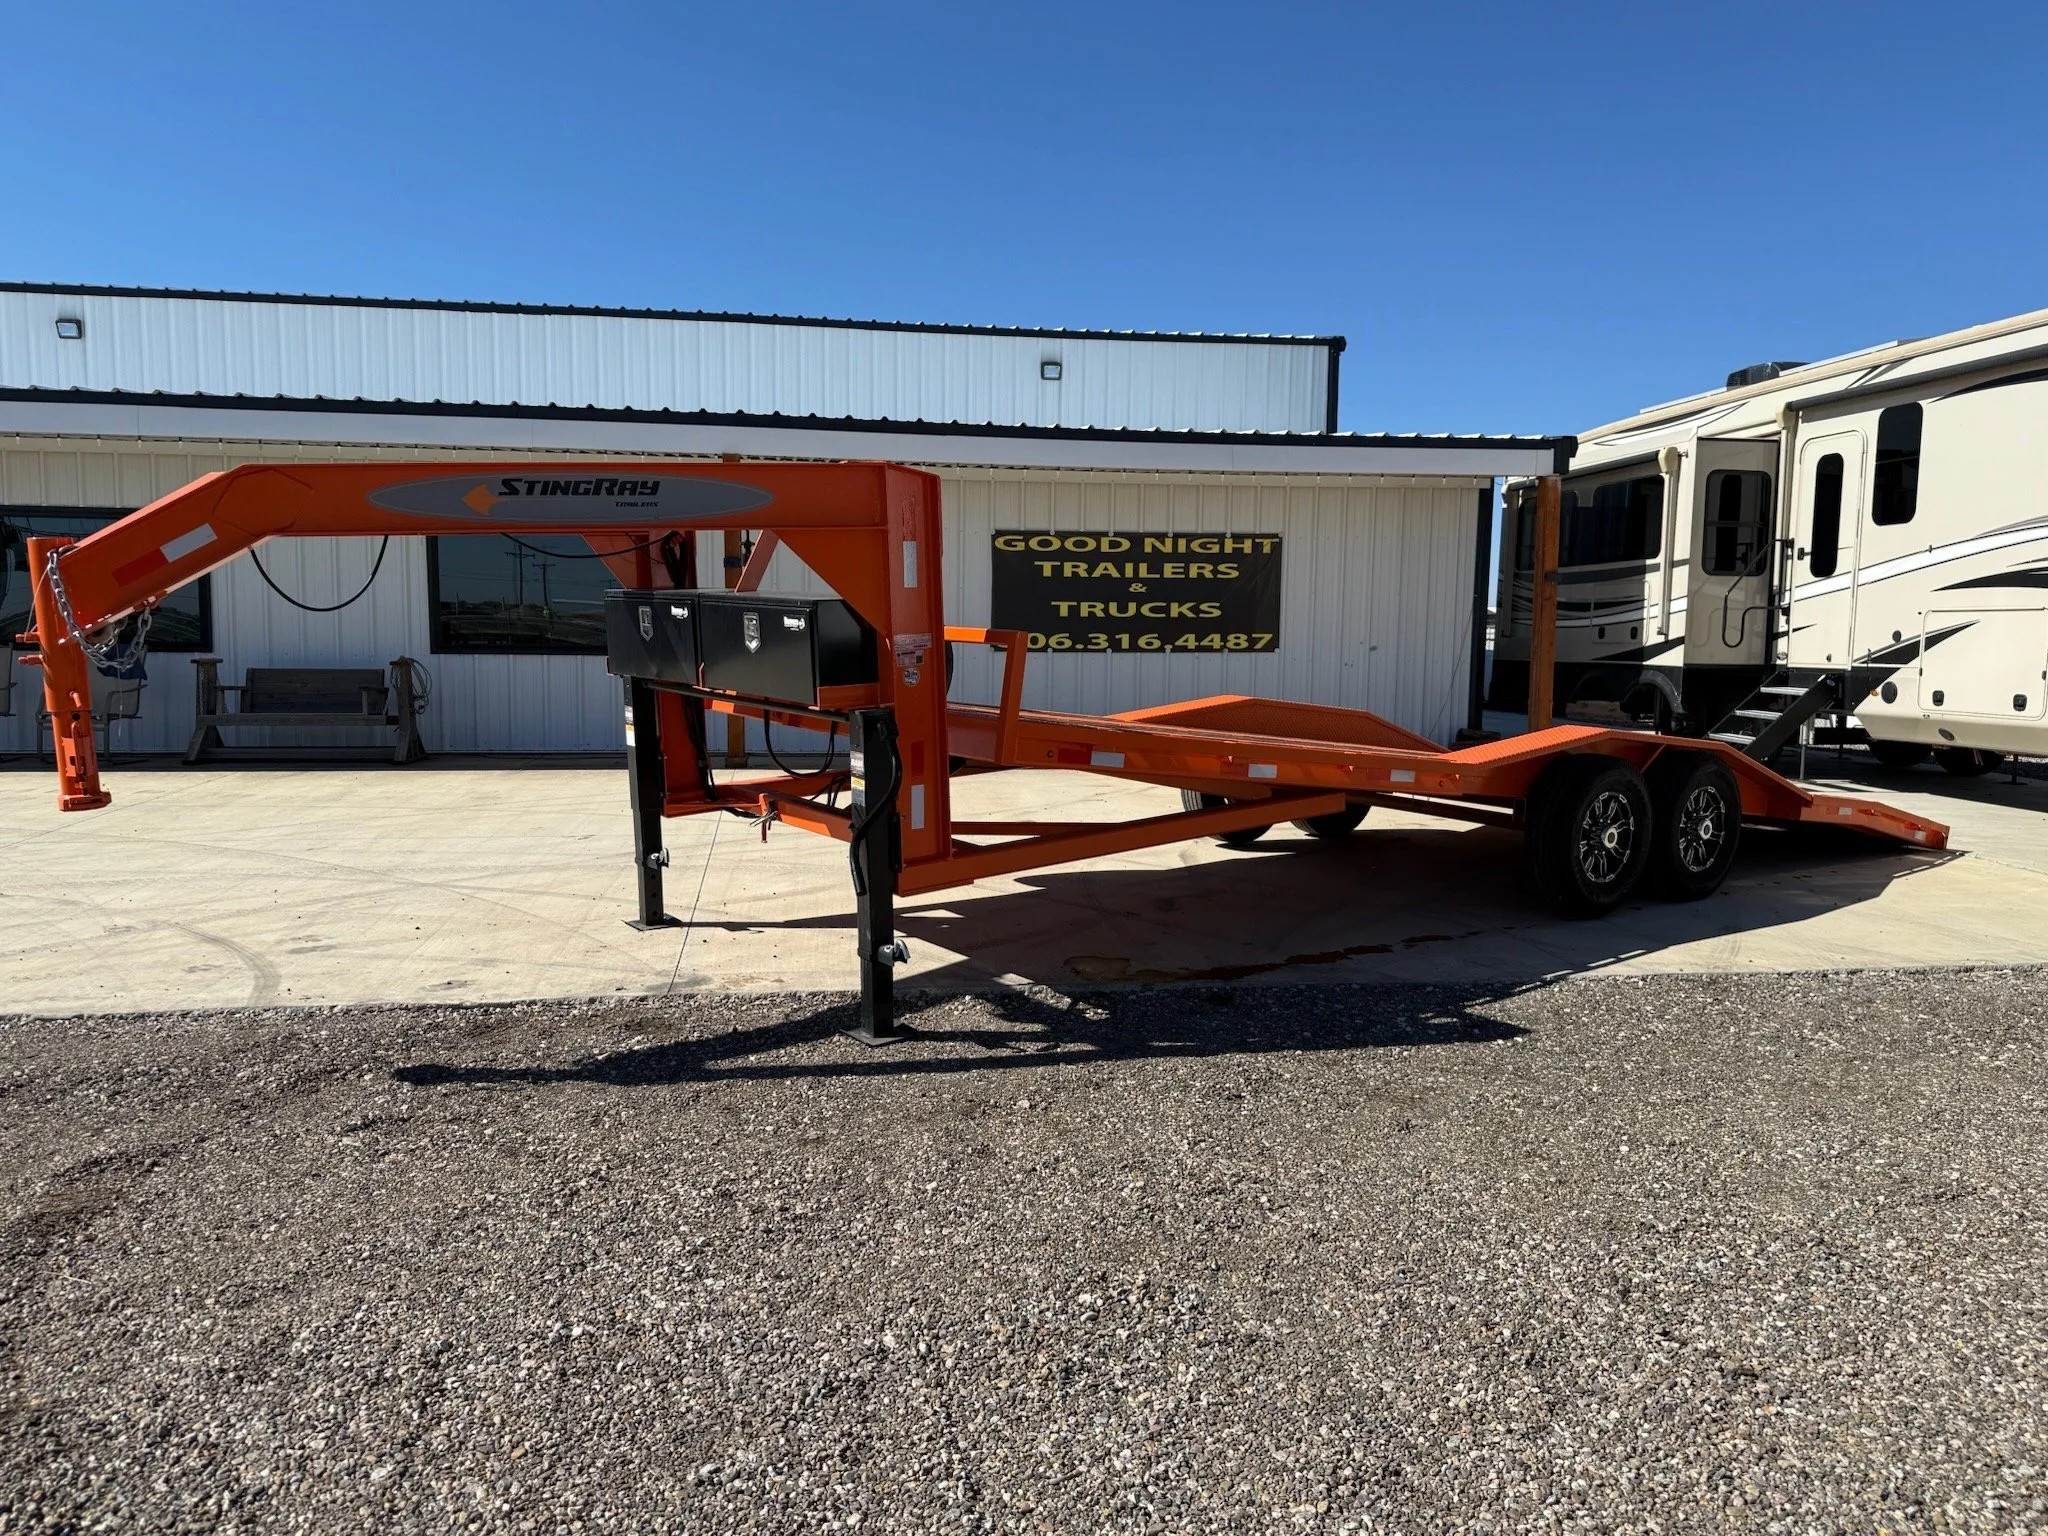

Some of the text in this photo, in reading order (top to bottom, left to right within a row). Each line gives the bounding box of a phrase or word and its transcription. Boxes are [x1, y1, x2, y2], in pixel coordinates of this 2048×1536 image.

[994, 535, 1281, 554] GOOD NIGHT
[1034, 561, 1240, 579] TRAILERS
[1128, 582, 1148, 593] &
[1051, 601, 1222, 618] TRUCKS
[998, 632, 1274, 650] 06.316.4487
